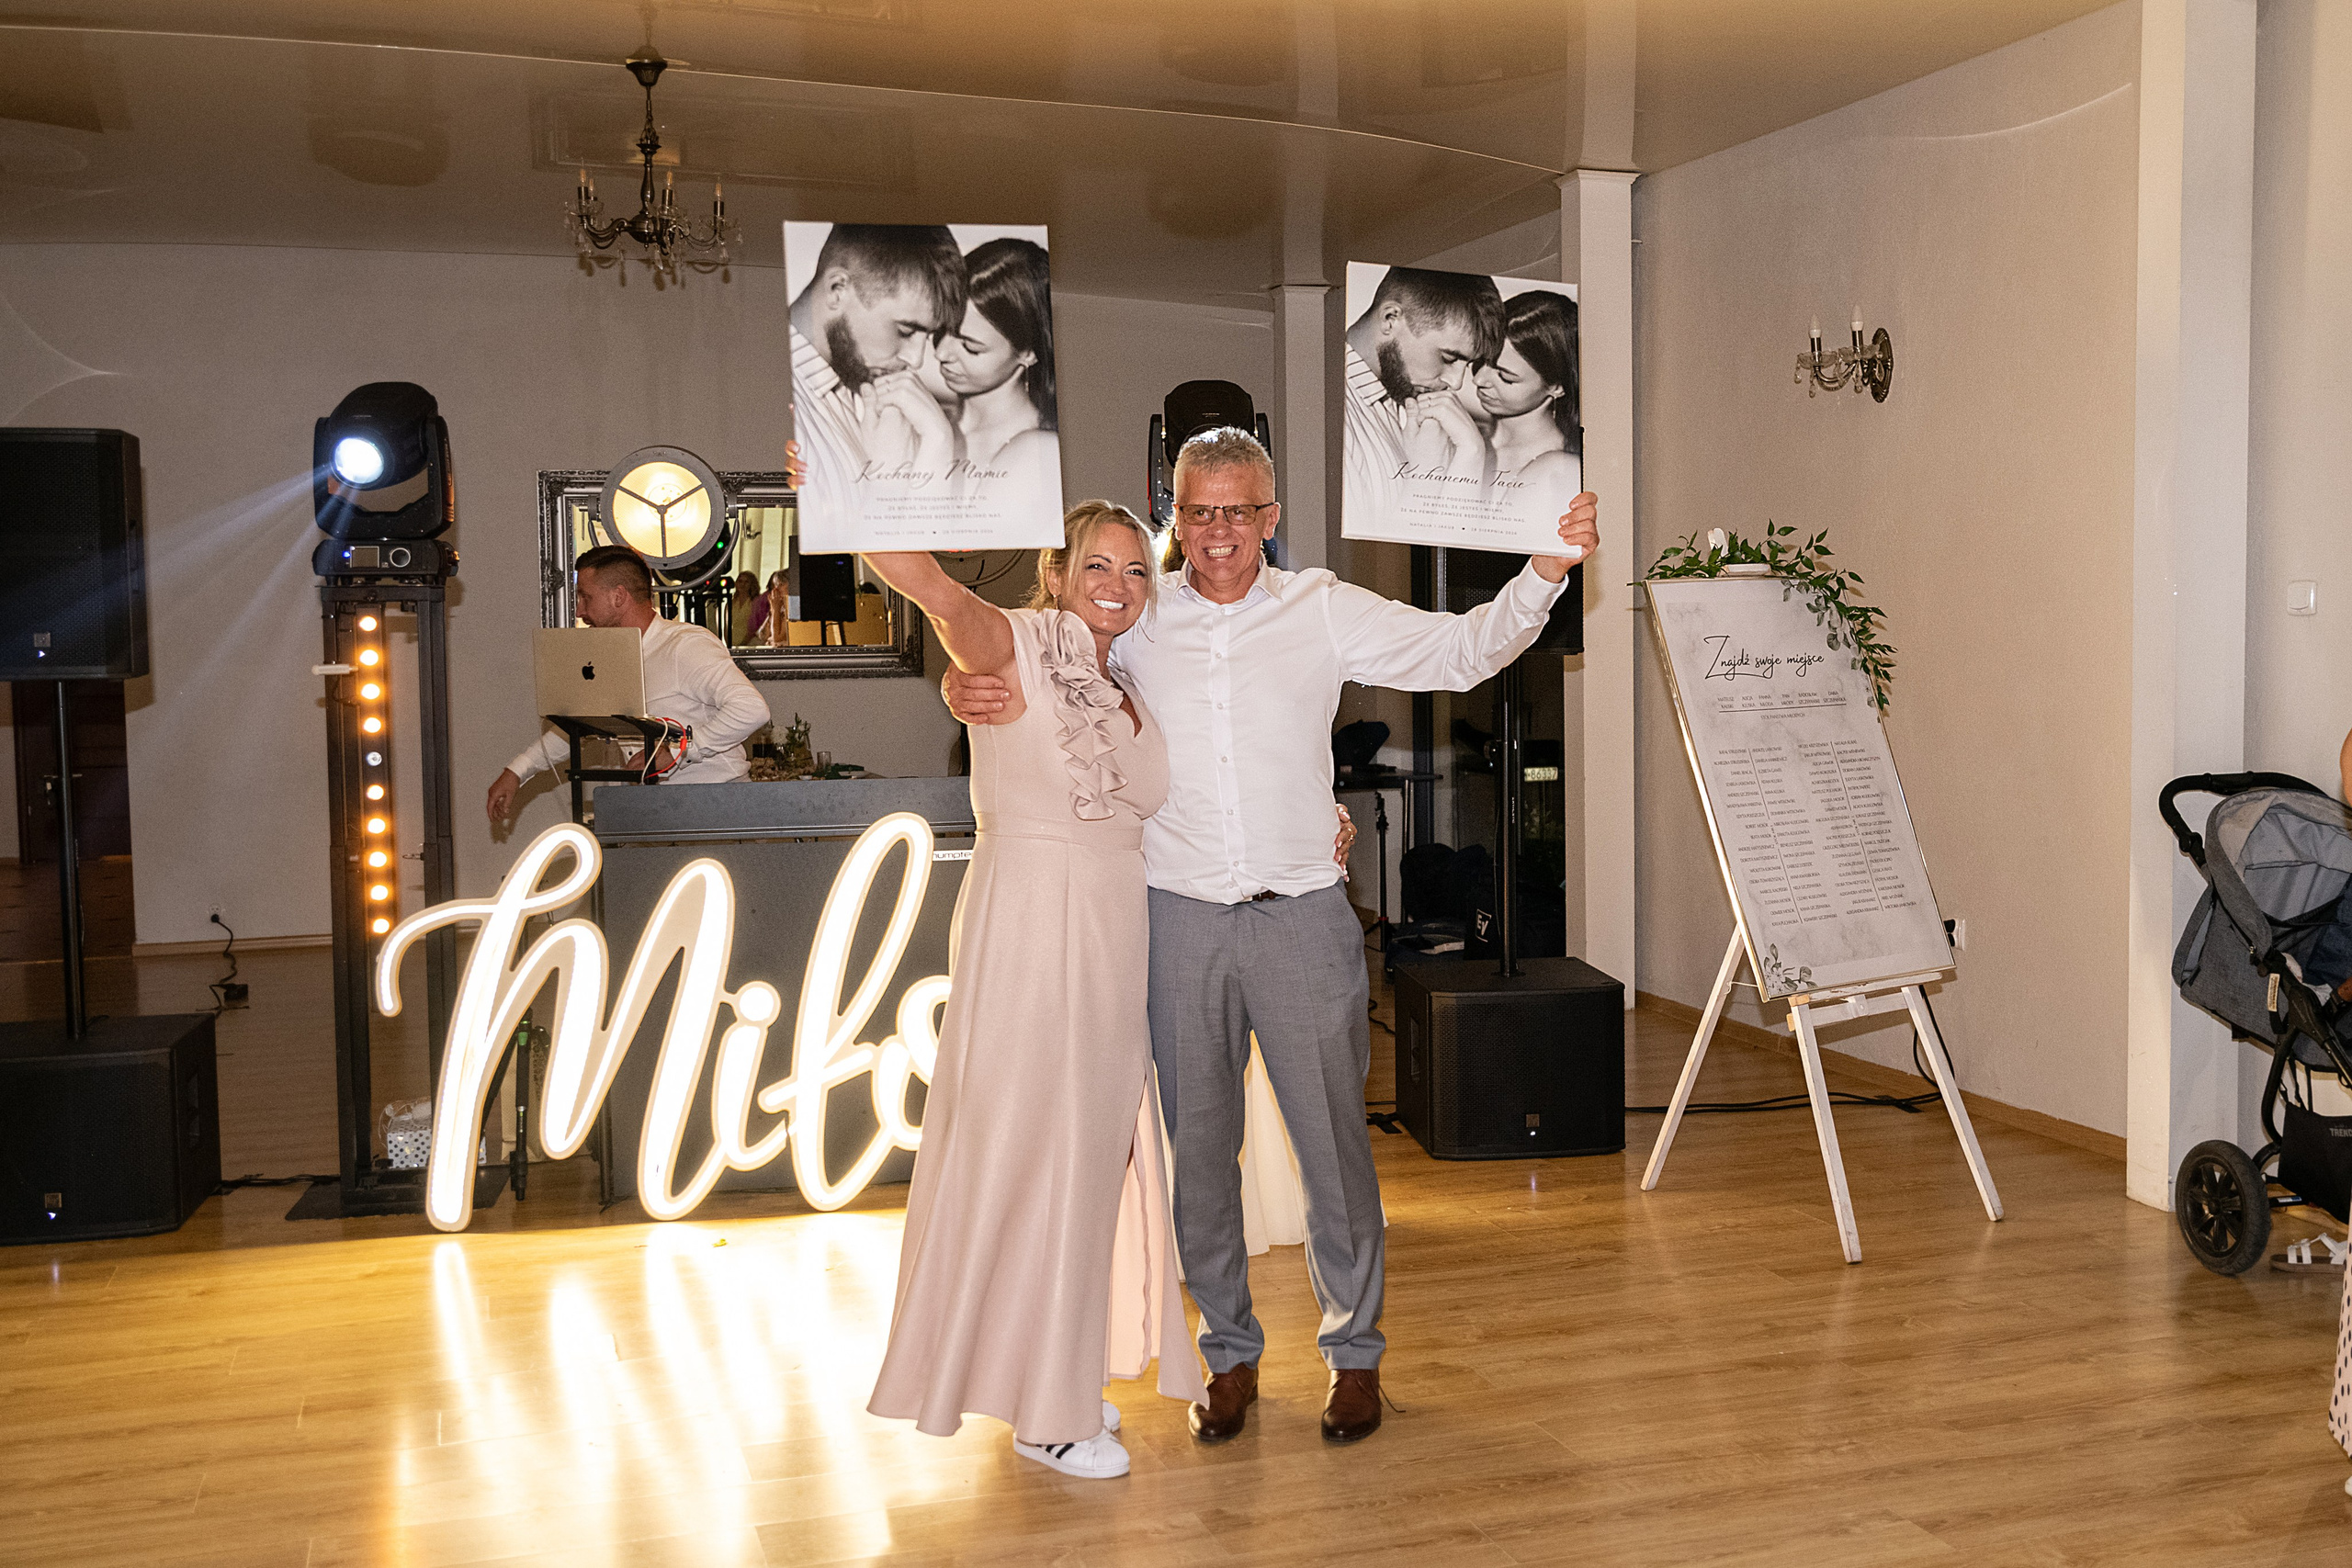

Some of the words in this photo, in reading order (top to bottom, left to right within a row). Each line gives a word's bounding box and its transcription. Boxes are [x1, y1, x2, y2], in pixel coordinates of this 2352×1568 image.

[944, 458, 1009, 480] Mamie
[1390, 461, 1479, 485] Kochanemu
[1489, 469, 1536, 489] Tacie
[1703, 635, 1755, 681] Znajdź
[1755, 654, 1781, 679] swoje
[1786, 652, 1824, 677] miejsce
